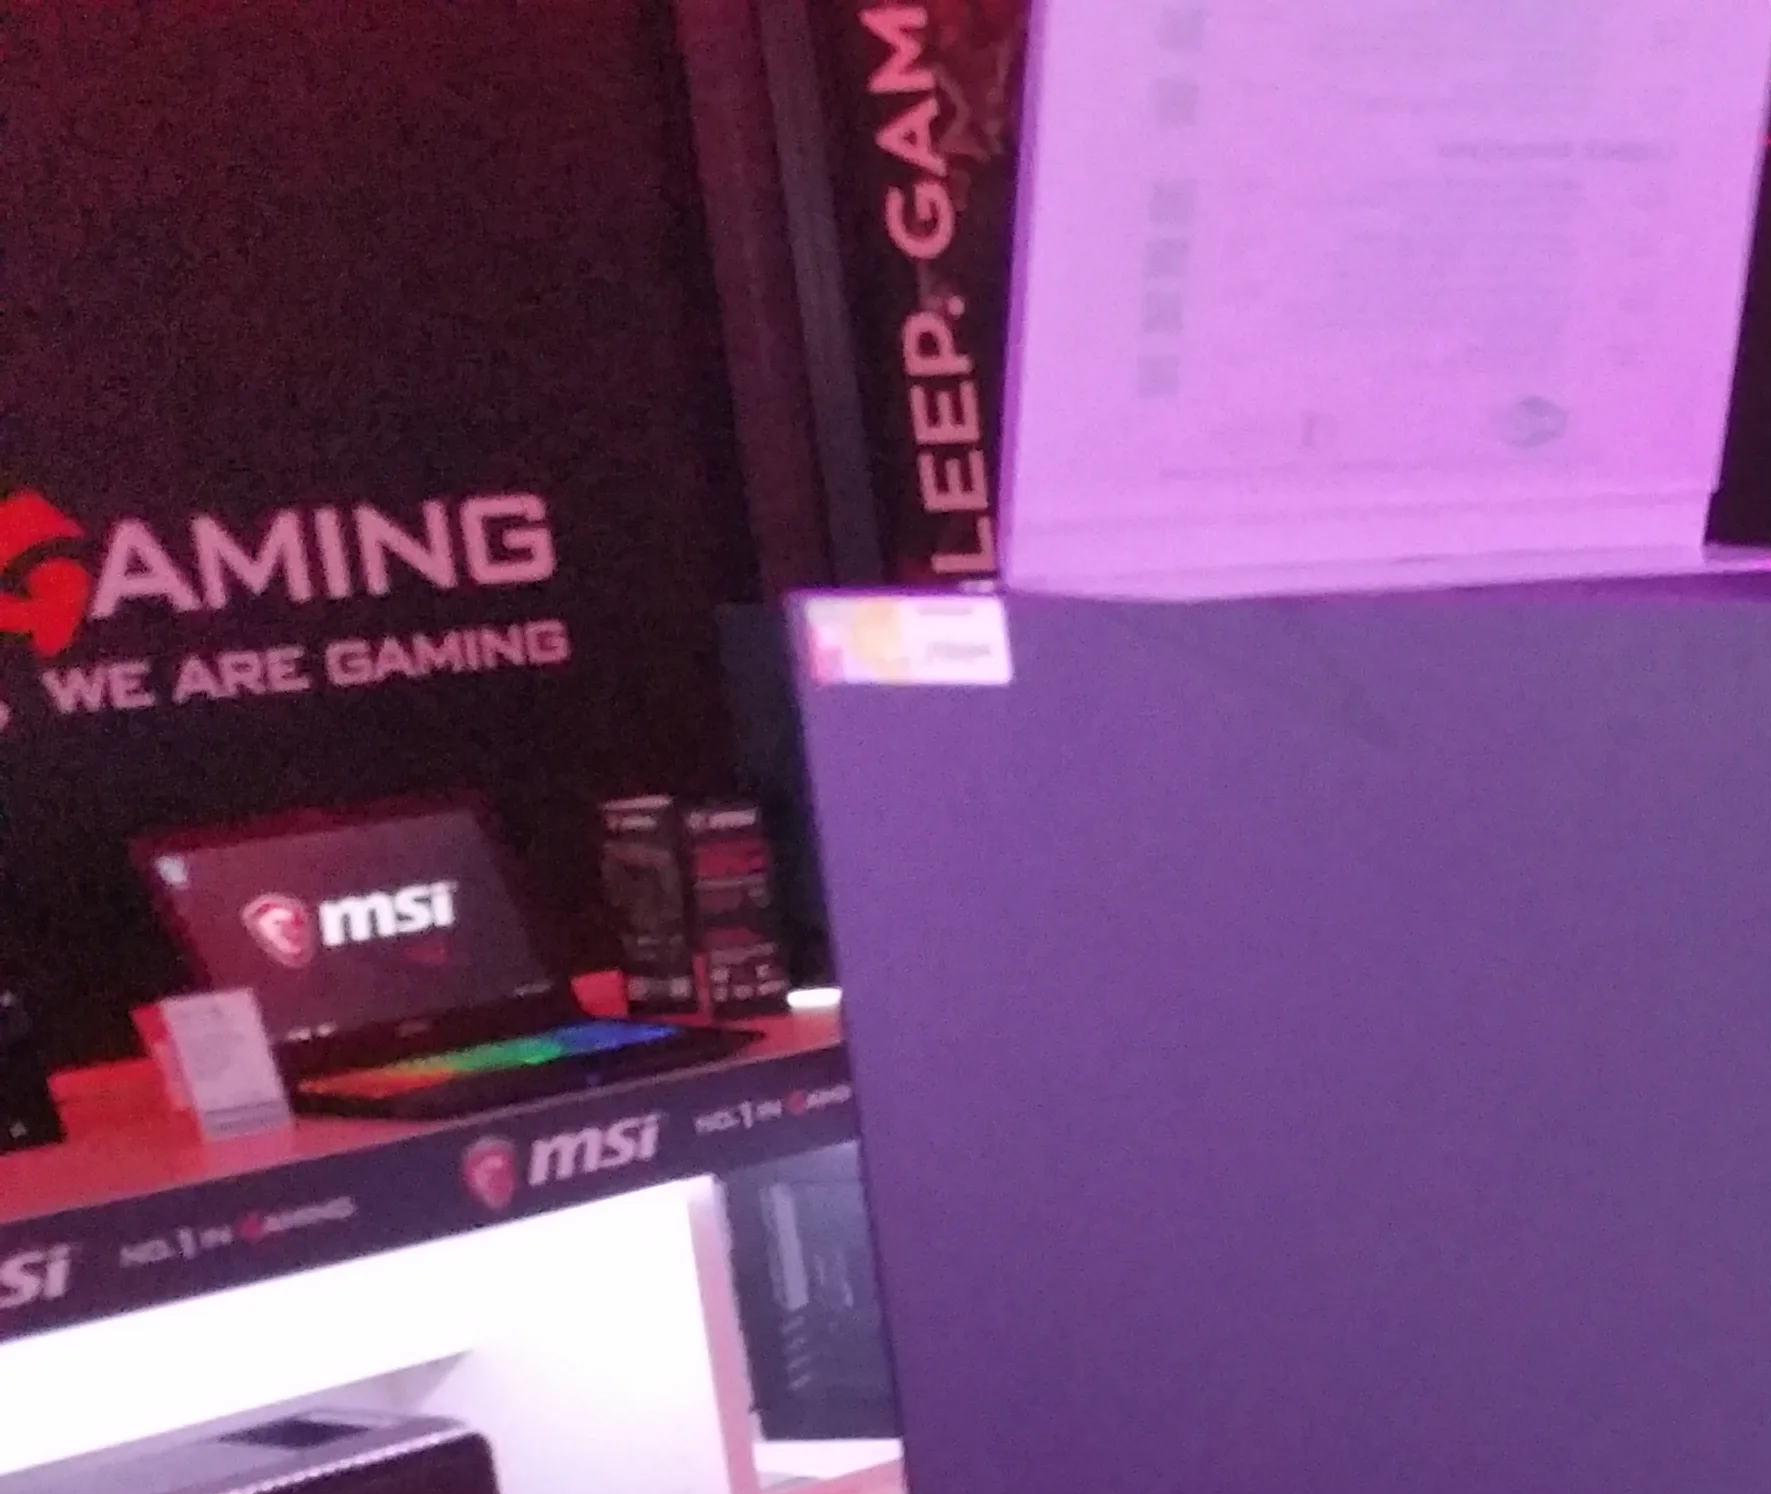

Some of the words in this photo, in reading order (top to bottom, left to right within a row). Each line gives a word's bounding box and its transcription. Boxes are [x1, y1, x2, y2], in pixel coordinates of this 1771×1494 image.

[902, 296, 997, 593] LEEP.
[41, 661, 155, 714] WE
[172, 644, 311, 702] ARE
[324, 619, 571, 688] GAMING
[318, 880, 457, 946] msi
[528, 1110, 664, 1187] msi
